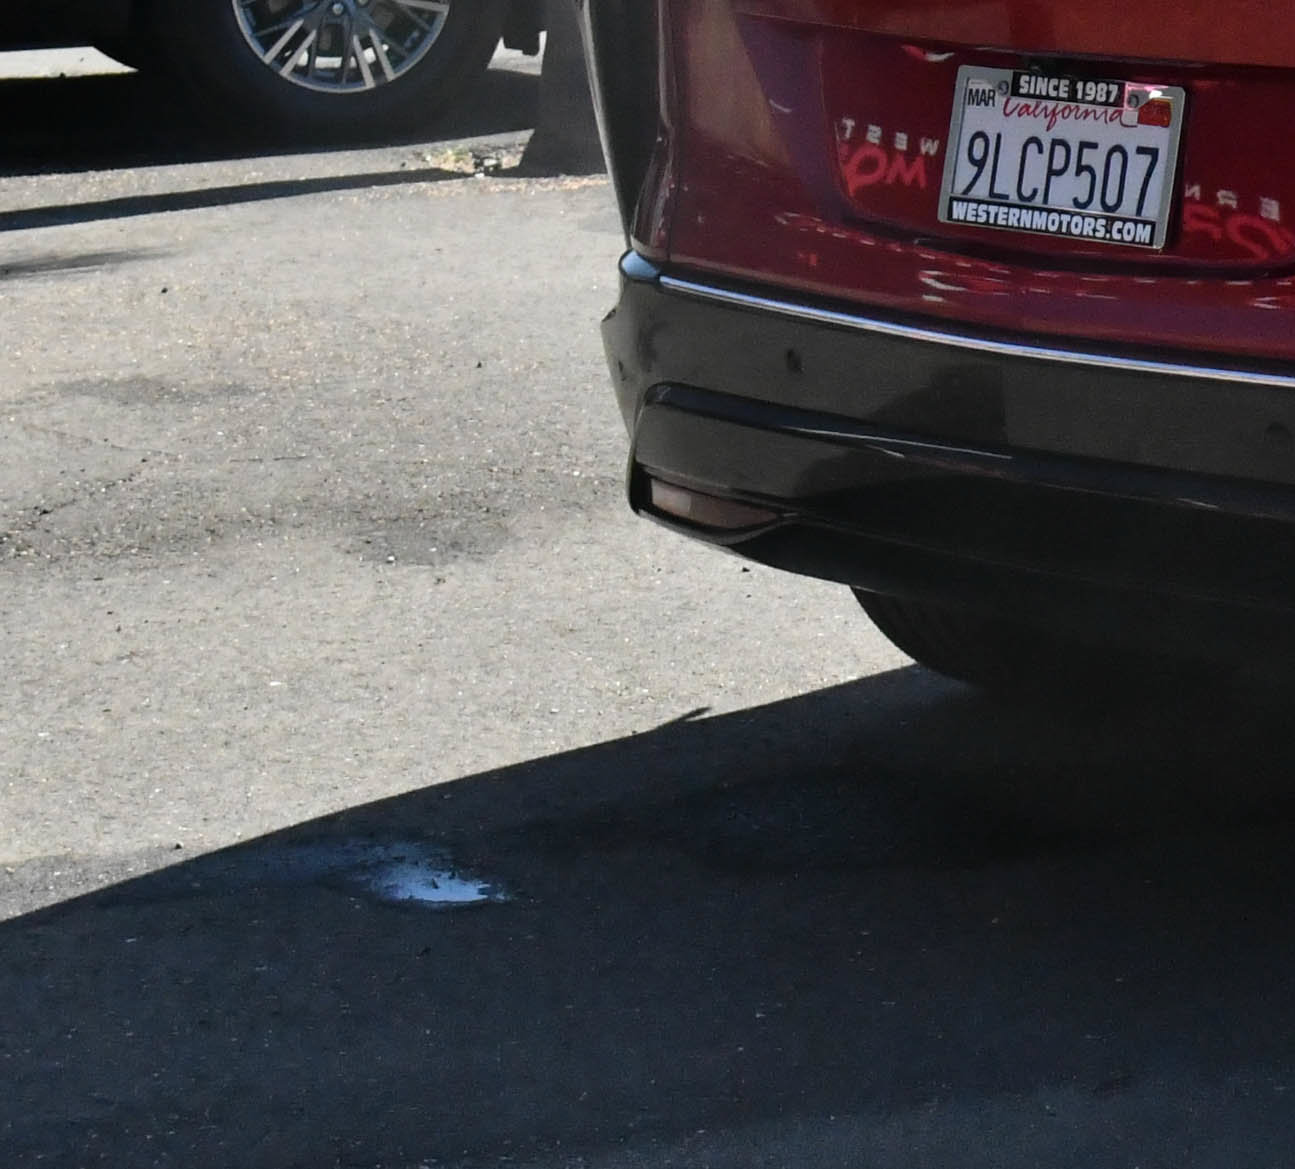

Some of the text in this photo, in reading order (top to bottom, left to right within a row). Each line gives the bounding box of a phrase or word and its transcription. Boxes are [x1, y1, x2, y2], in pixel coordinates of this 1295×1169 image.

[967, 87, 996, 108] MAR
[1019, 75, 1119, 103] SINCE 1987
[1003, 96, 1138, 131] California
[963, 130, 1160, 218] 9LCP507
[952, 200, 1152, 245] WESTERNMOTORS.COM
